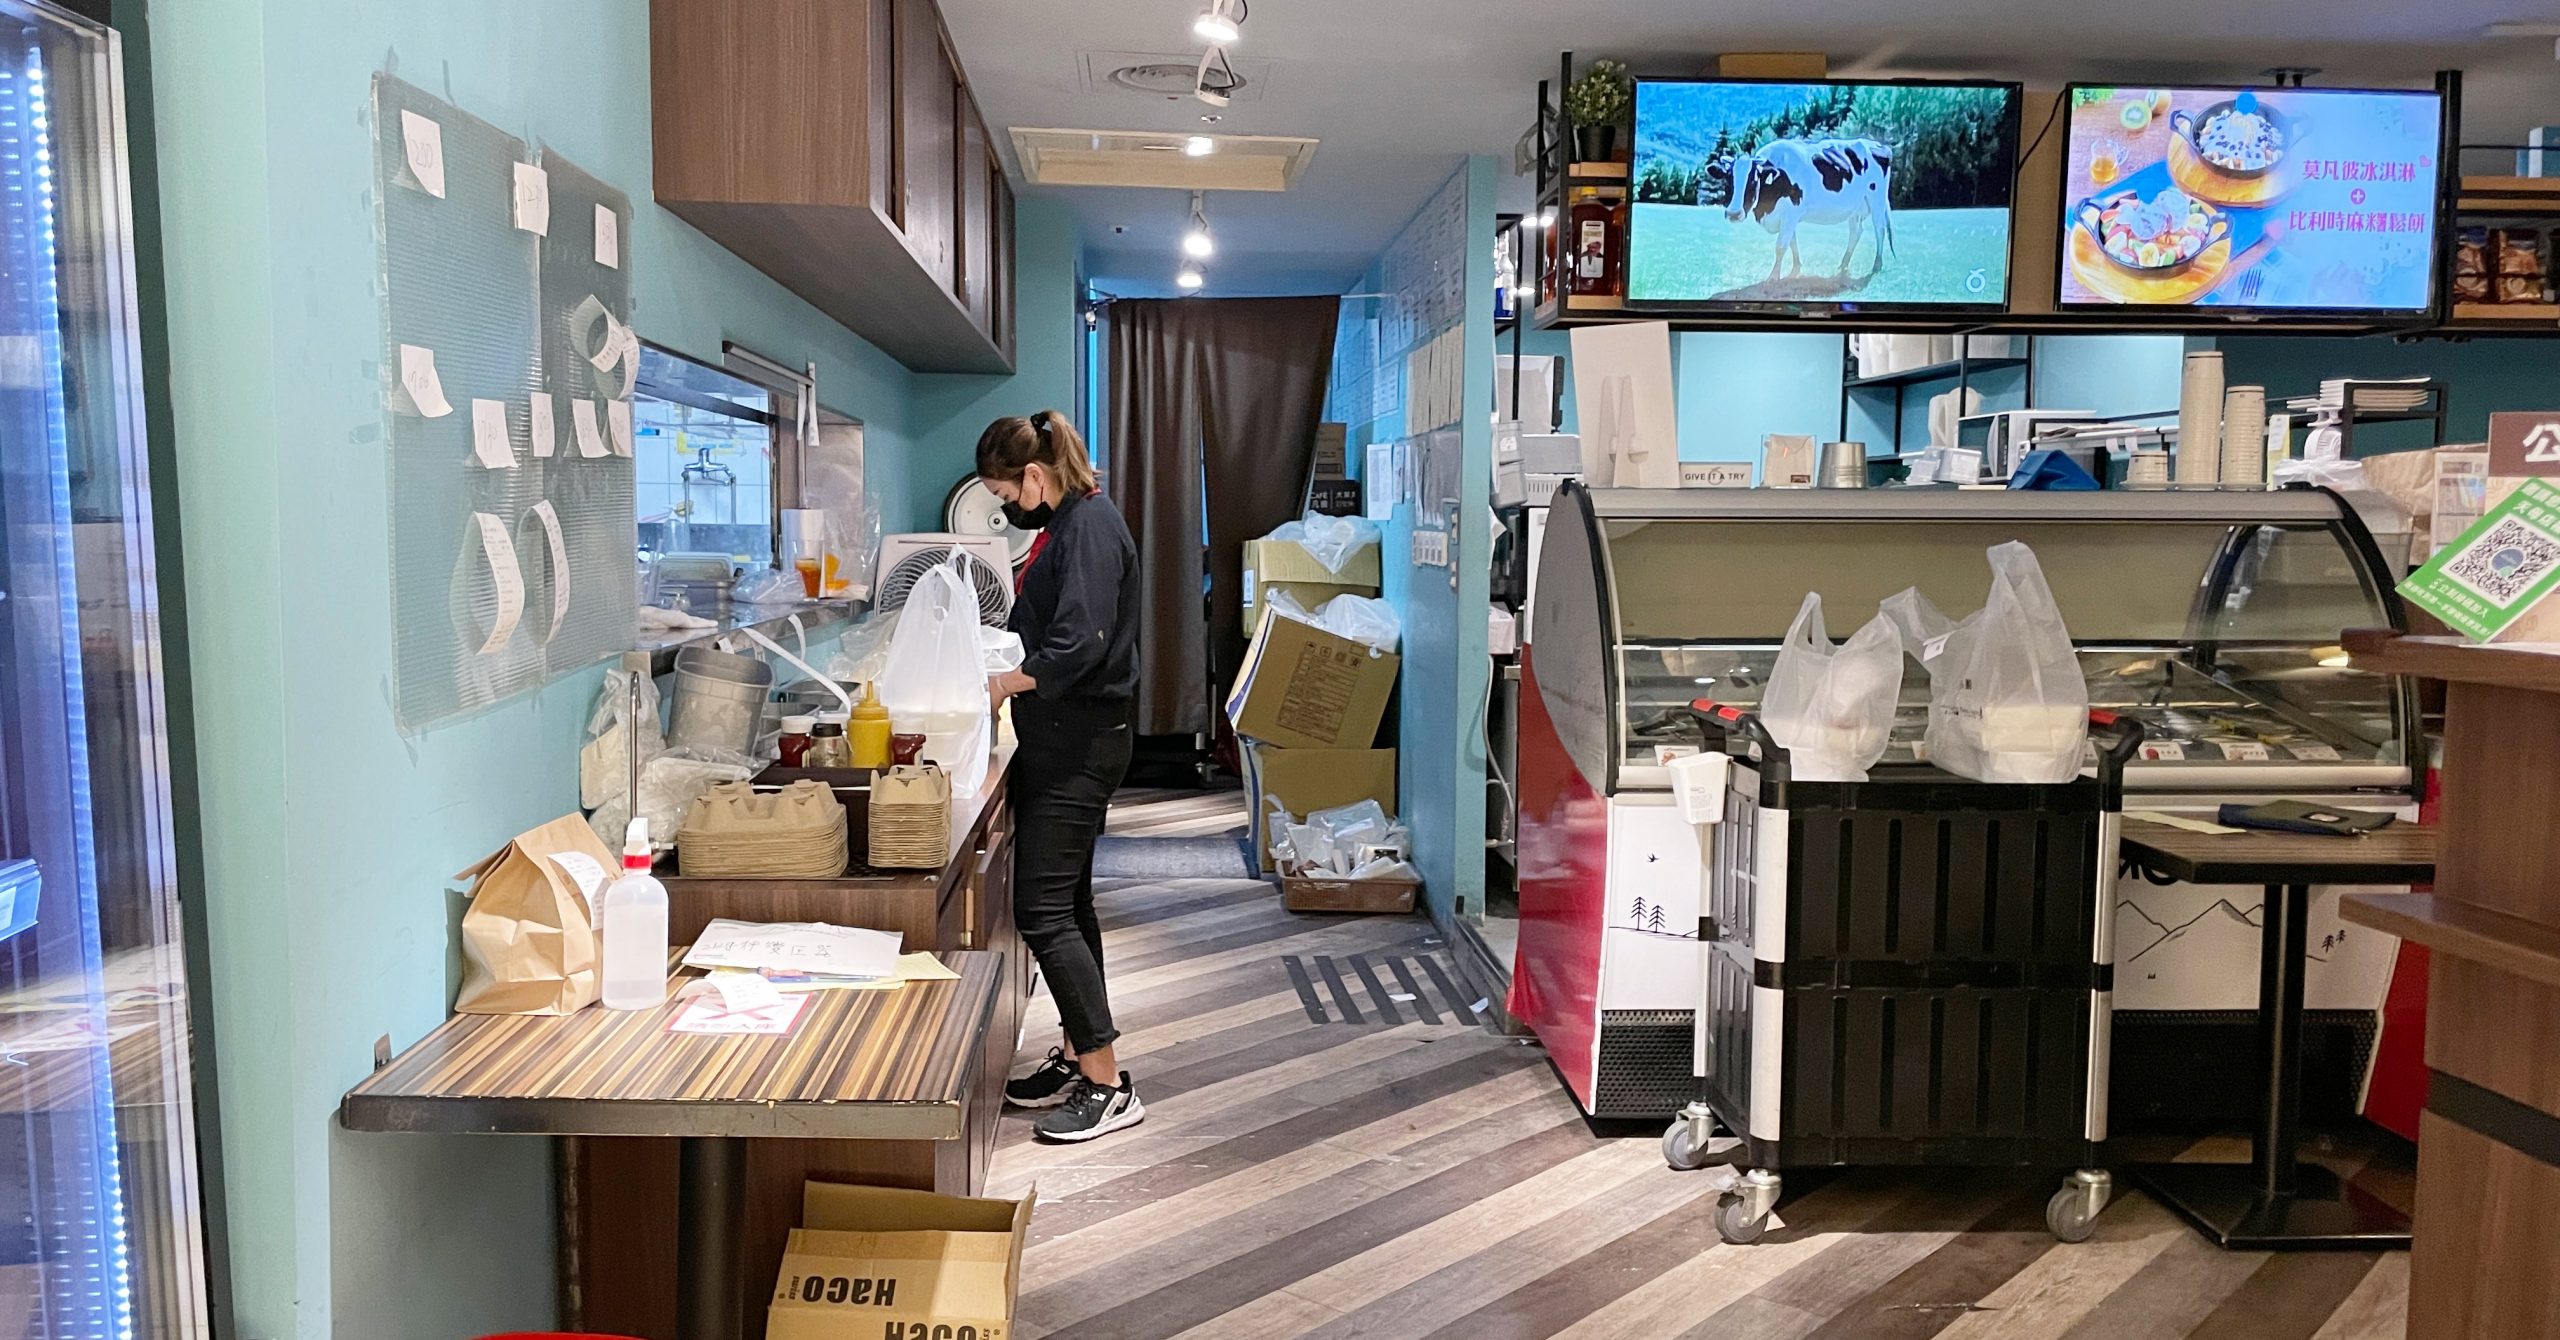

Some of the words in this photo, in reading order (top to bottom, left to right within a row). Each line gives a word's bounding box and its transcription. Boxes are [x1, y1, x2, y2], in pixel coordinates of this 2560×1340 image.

[2302, 159, 2417, 182] 莫凡彼冰淇淋
[1684, 473, 1706, 481] GIVE
[1708, 473, 1717, 481] IT
[1728, 472, 1746, 480] TRY
